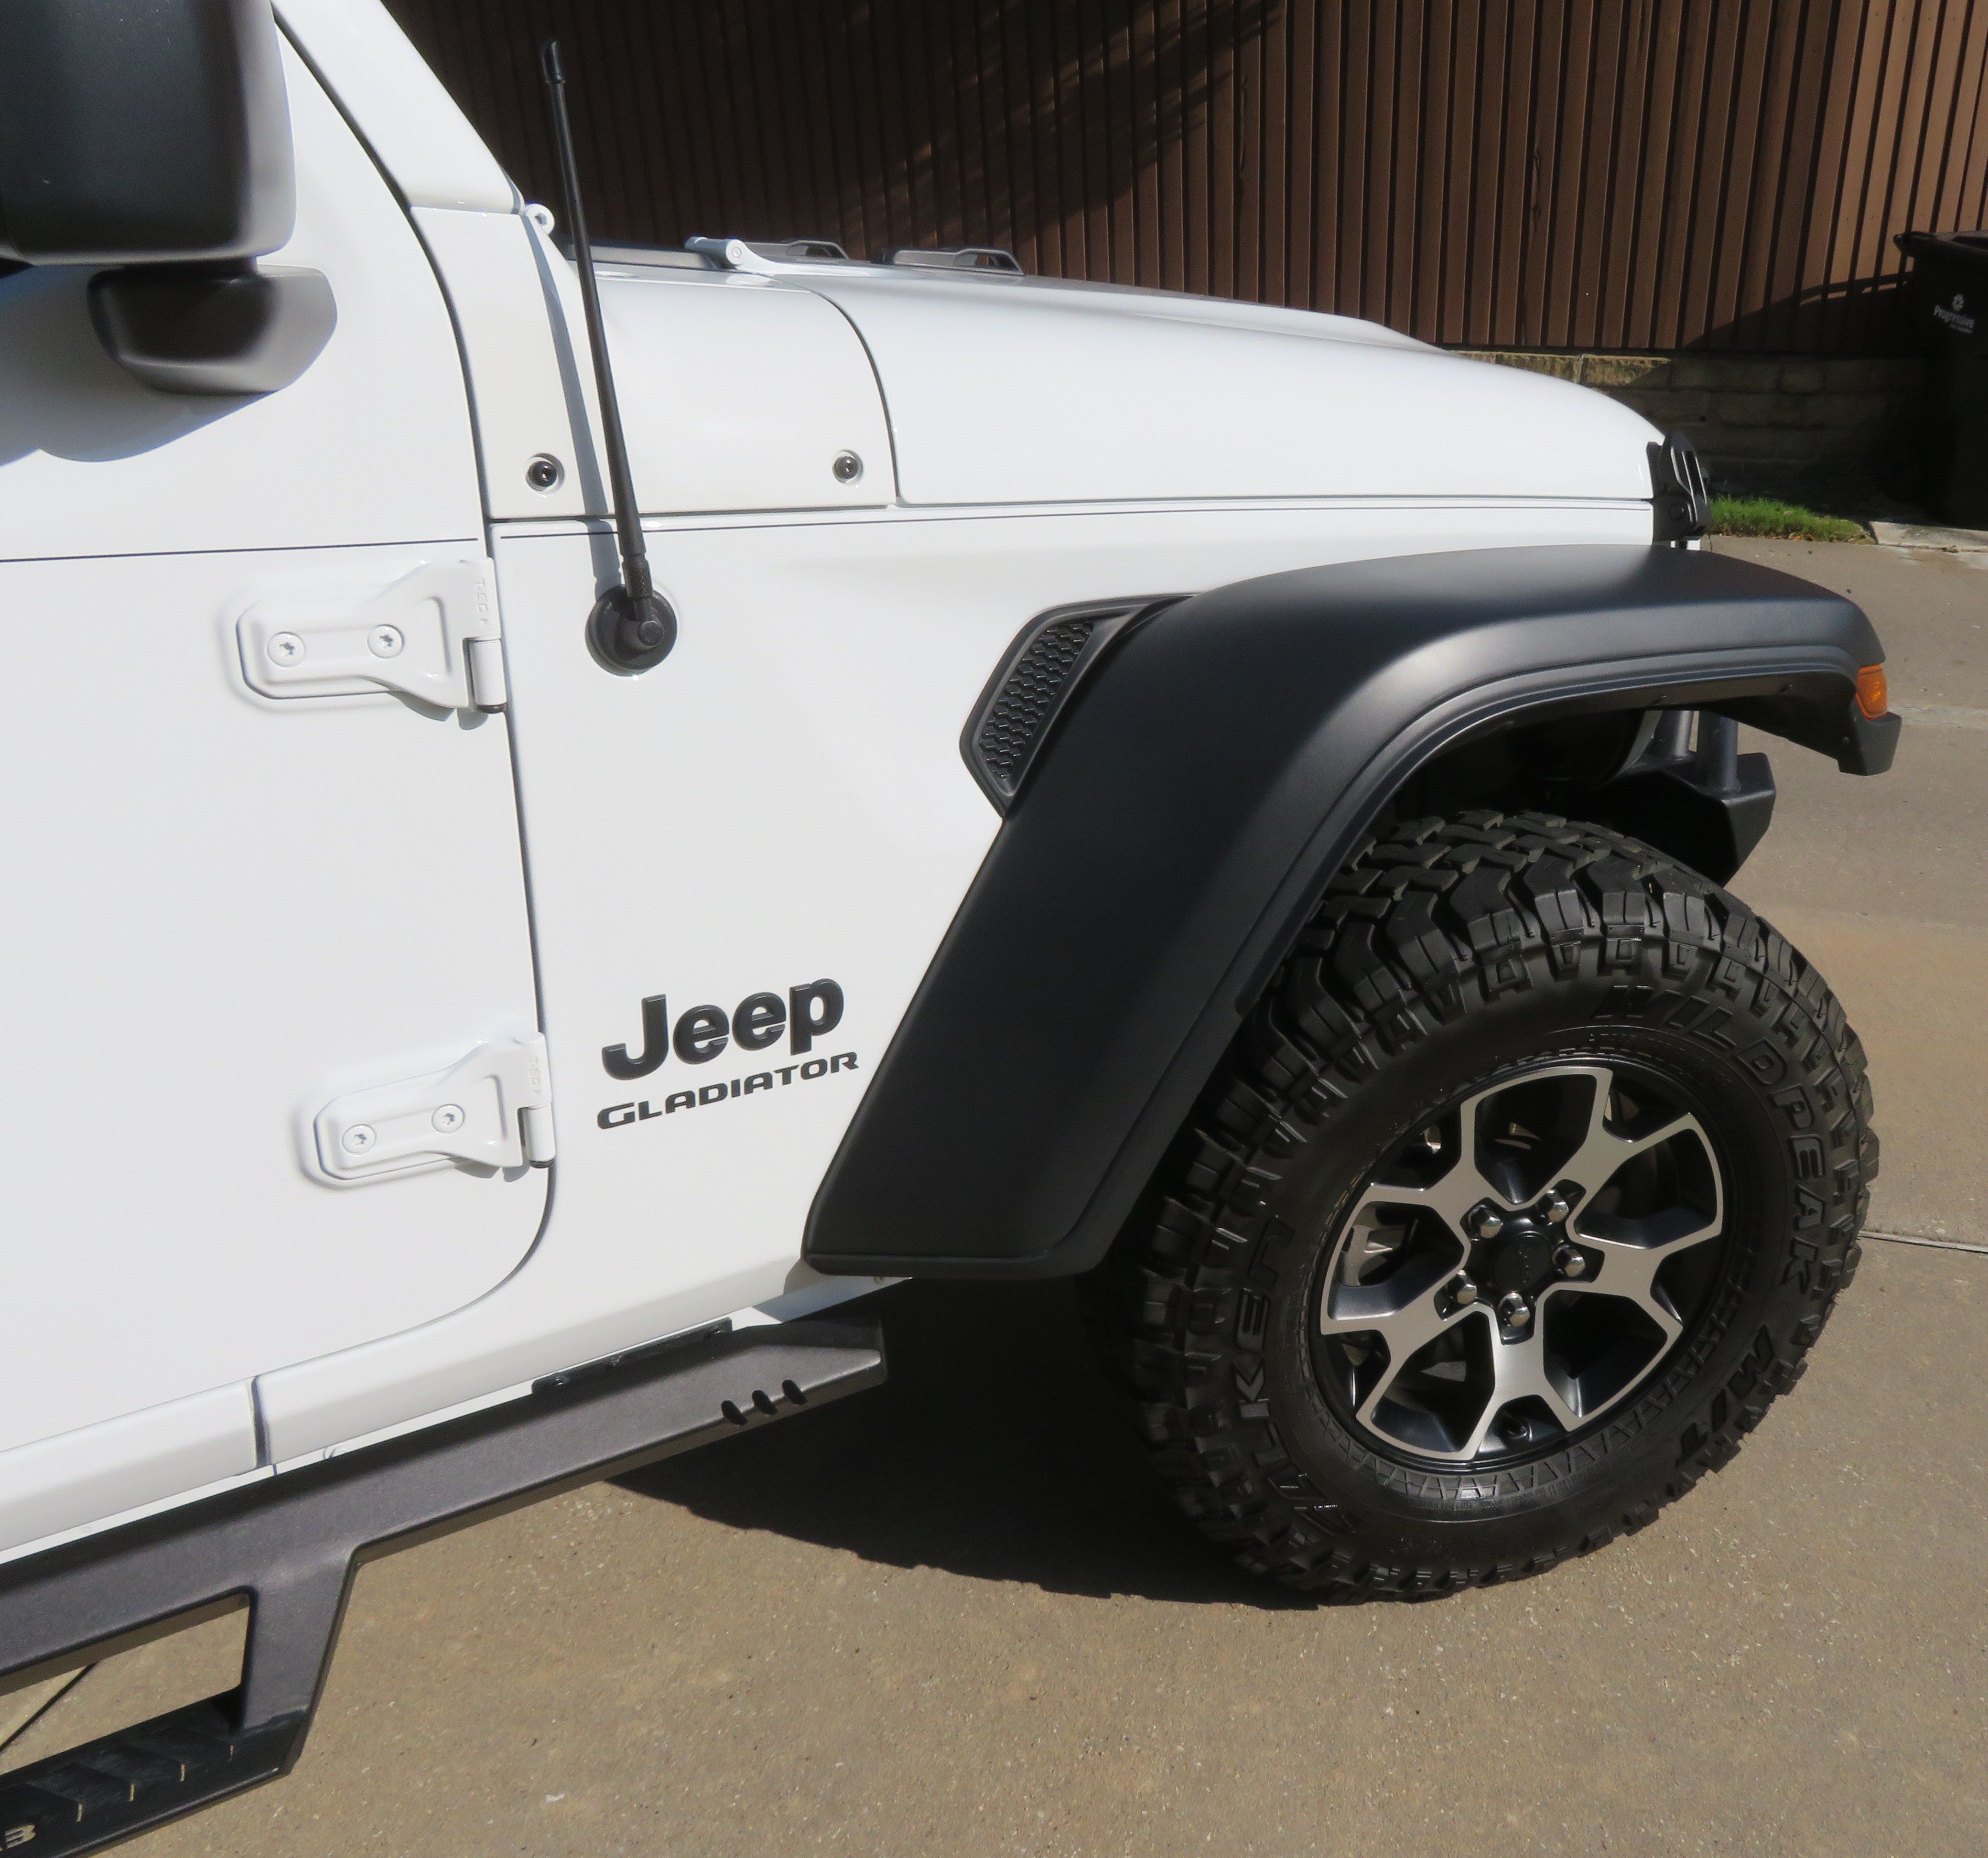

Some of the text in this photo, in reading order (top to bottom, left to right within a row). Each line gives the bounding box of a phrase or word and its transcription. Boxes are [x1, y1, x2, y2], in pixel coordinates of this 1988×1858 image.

[601, 978, 844, 1081] Jeep
[597, 1051, 860, 1130] GLADIATOR
[1591, 984, 1826, 1295] WILDPEAK
